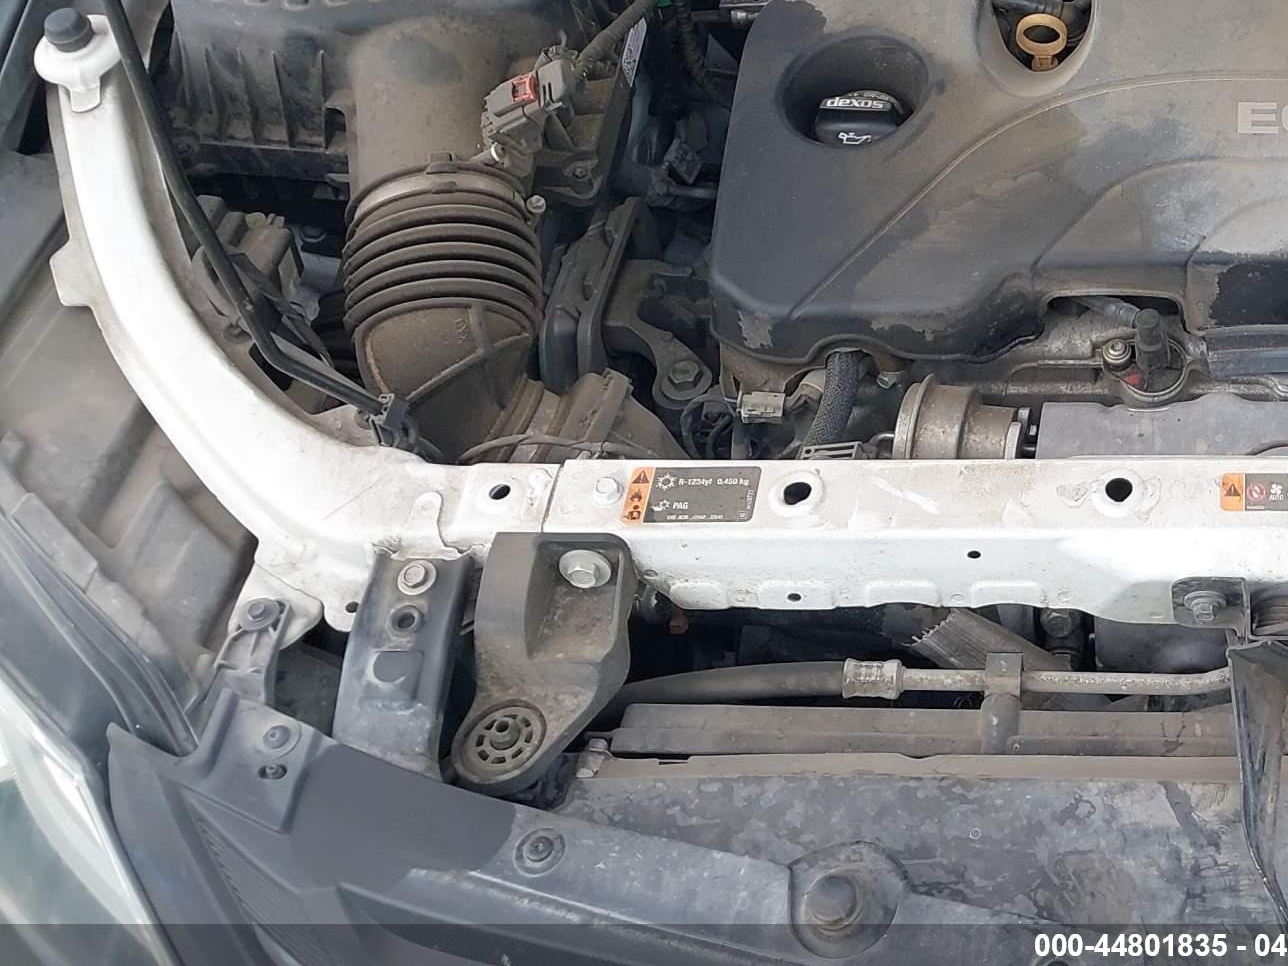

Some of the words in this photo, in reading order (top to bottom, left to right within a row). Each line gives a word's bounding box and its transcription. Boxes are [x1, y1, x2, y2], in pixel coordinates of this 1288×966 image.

[826, 97, 884, 109] dexos
[738, 477, 750, 487] kg
[672, 501, 689, 510] PAG
